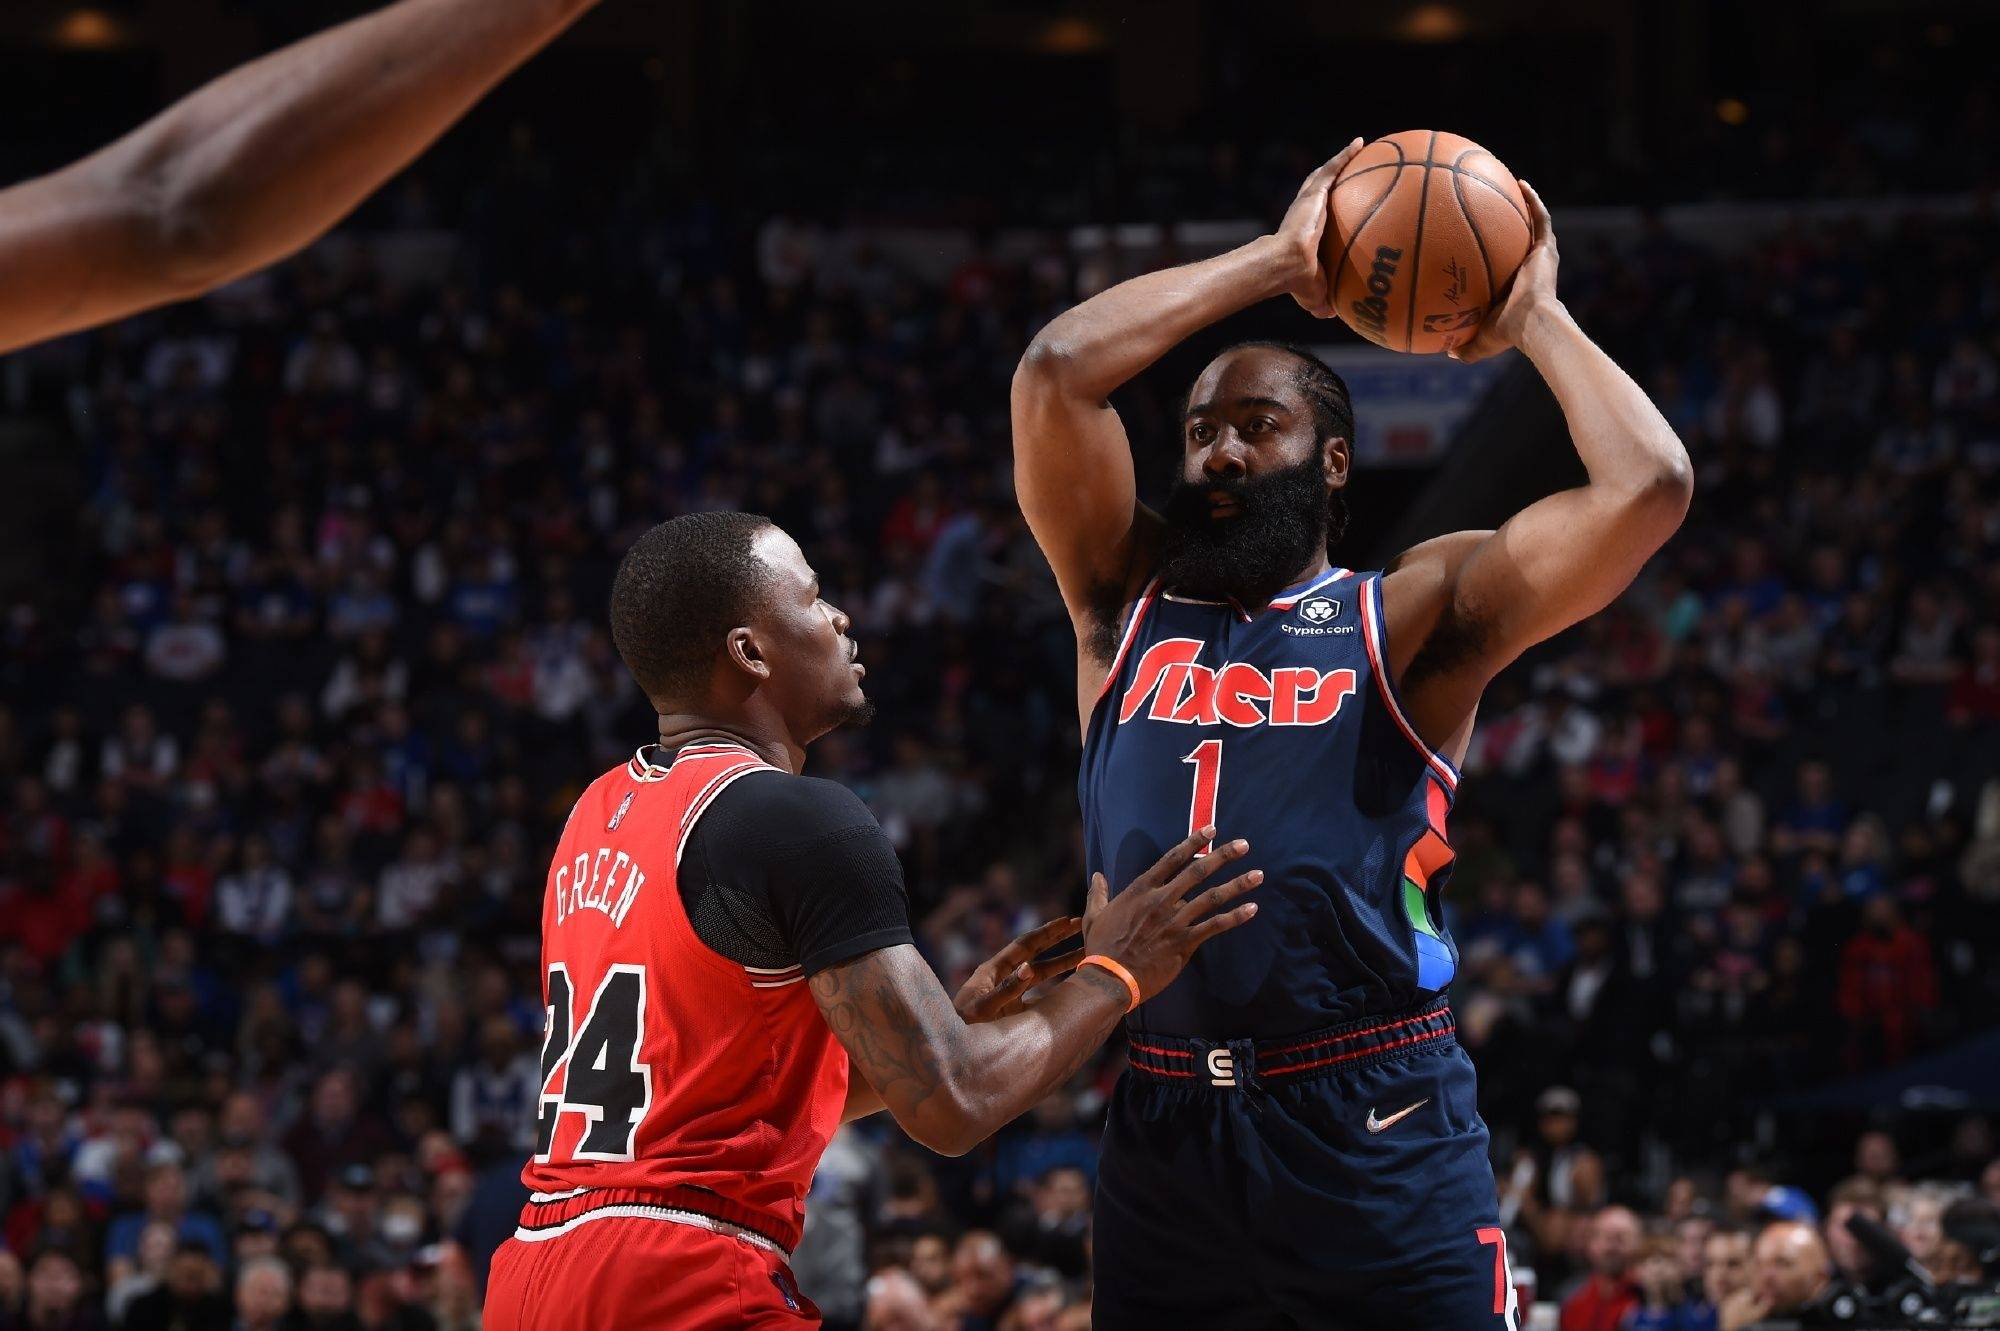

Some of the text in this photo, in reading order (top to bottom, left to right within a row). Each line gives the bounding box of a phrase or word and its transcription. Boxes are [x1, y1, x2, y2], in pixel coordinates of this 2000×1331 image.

[1281, 624, 1354, 636] crypto.com
[1119, 637, 1356, 728] Sixers
[1182, 739, 1223, 858] 1
[556, 847, 646, 930] GREEN
[534, 962, 652, 1163] 24
